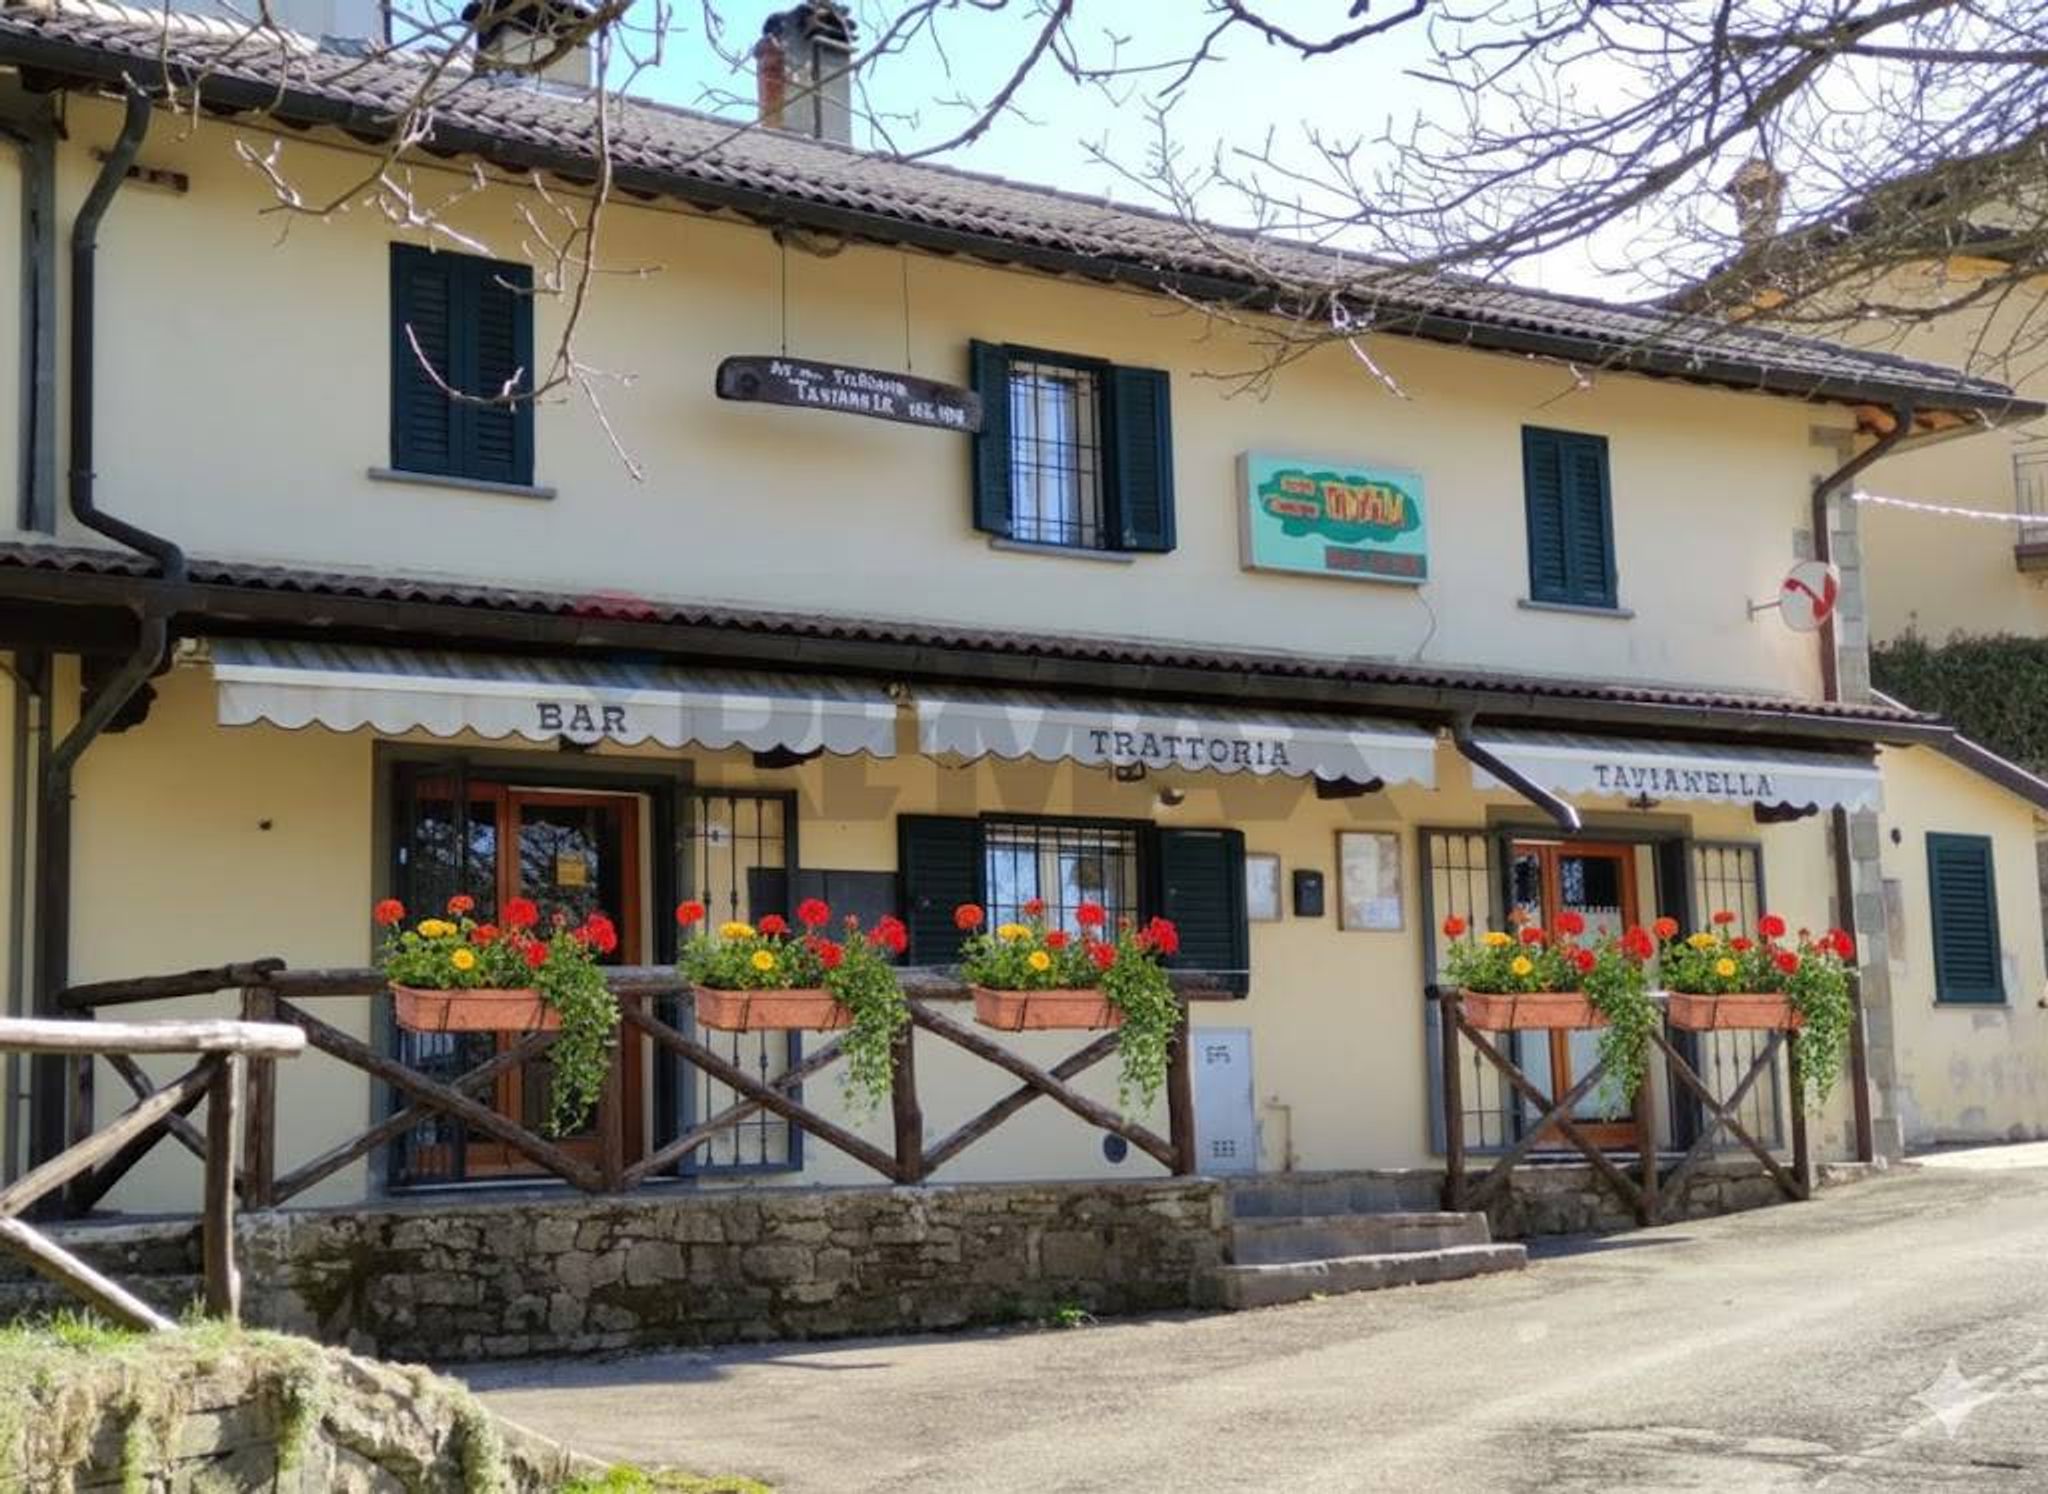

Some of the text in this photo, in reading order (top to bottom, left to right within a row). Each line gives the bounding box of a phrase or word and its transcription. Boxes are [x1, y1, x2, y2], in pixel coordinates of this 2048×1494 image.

[537, 702, 627, 733] BAR
[1090, 730, 1291, 766] TRATTORIA
[1594, 765, 1774, 797] TAVIANELLA
